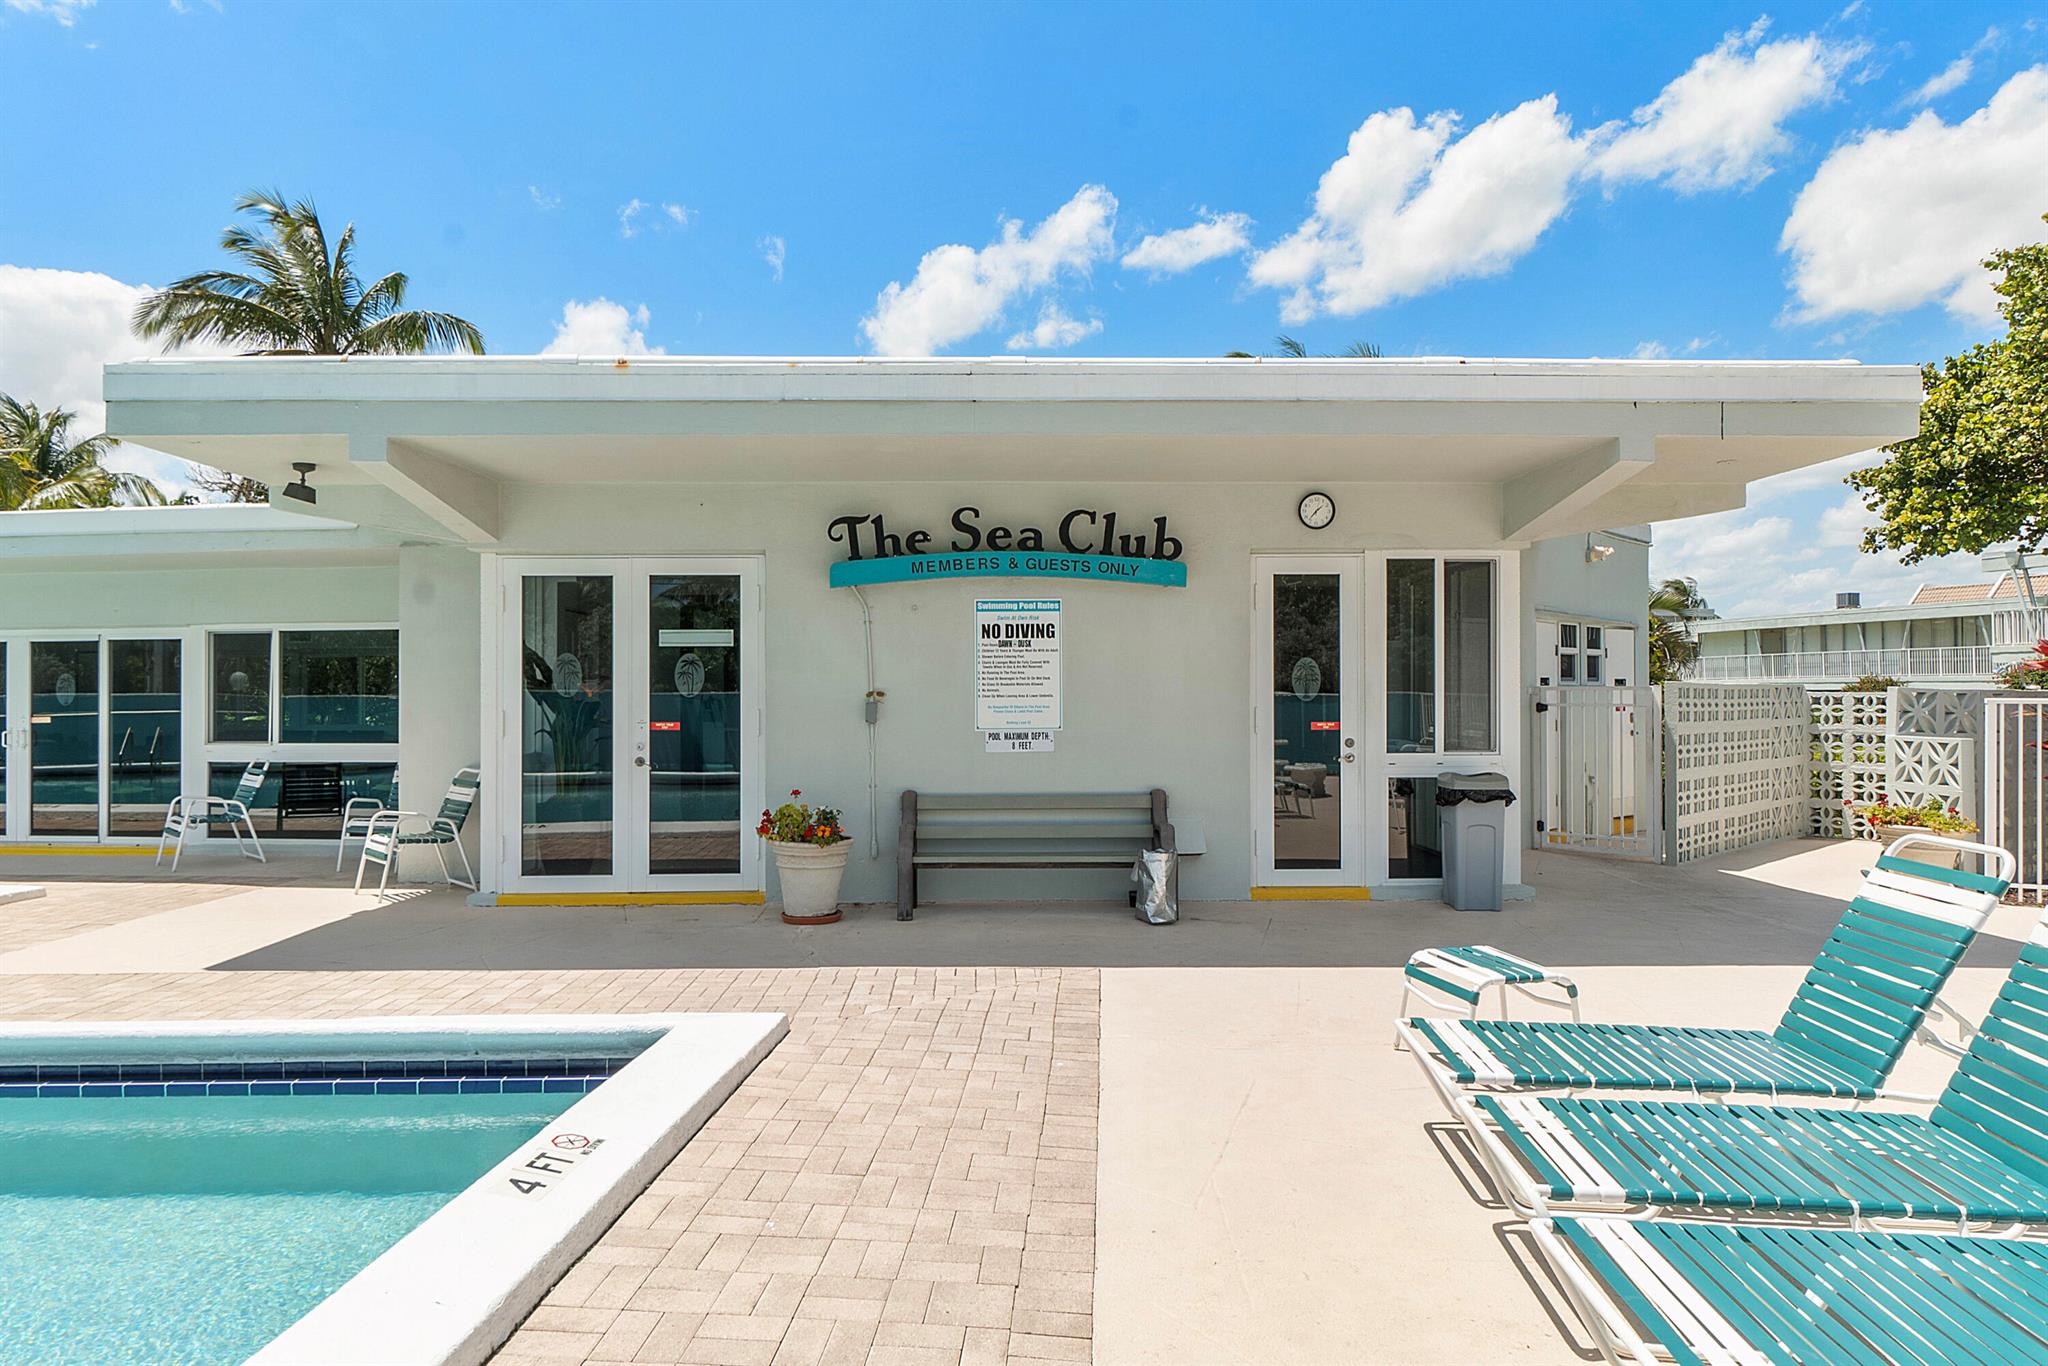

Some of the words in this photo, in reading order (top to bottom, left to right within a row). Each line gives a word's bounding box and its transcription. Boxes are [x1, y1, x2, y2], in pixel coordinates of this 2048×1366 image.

[827, 514, 932, 561] The
[950, 506, 1045, 553] Sea
[1058, 509, 1183, 561] Club
[911, 557, 1000, 574] MEMBERS
[1008, 557, 1019, 570] &
[1025, 557, 1091, 573] GUESTS
[1097, 561, 1140, 577] ONLY
[977, 602, 1018, 611] Swimming
[1019, 602, 1036, 610] Pool
[1037, 602, 1059, 610] Rules
[981, 623, 1001, 639] NO
[1005, 623, 1056, 639] DIVING
[998, 640, 1013, 648] DAWN
[1018, 640, 1032, 648] DUSK
[988, 732, 1001, 741] POOL
[1003, 732, 1029, 741] MAXIMUM
[525, 1152, 575, 1174] FT
[509, 1178, 547, 1194] 4
